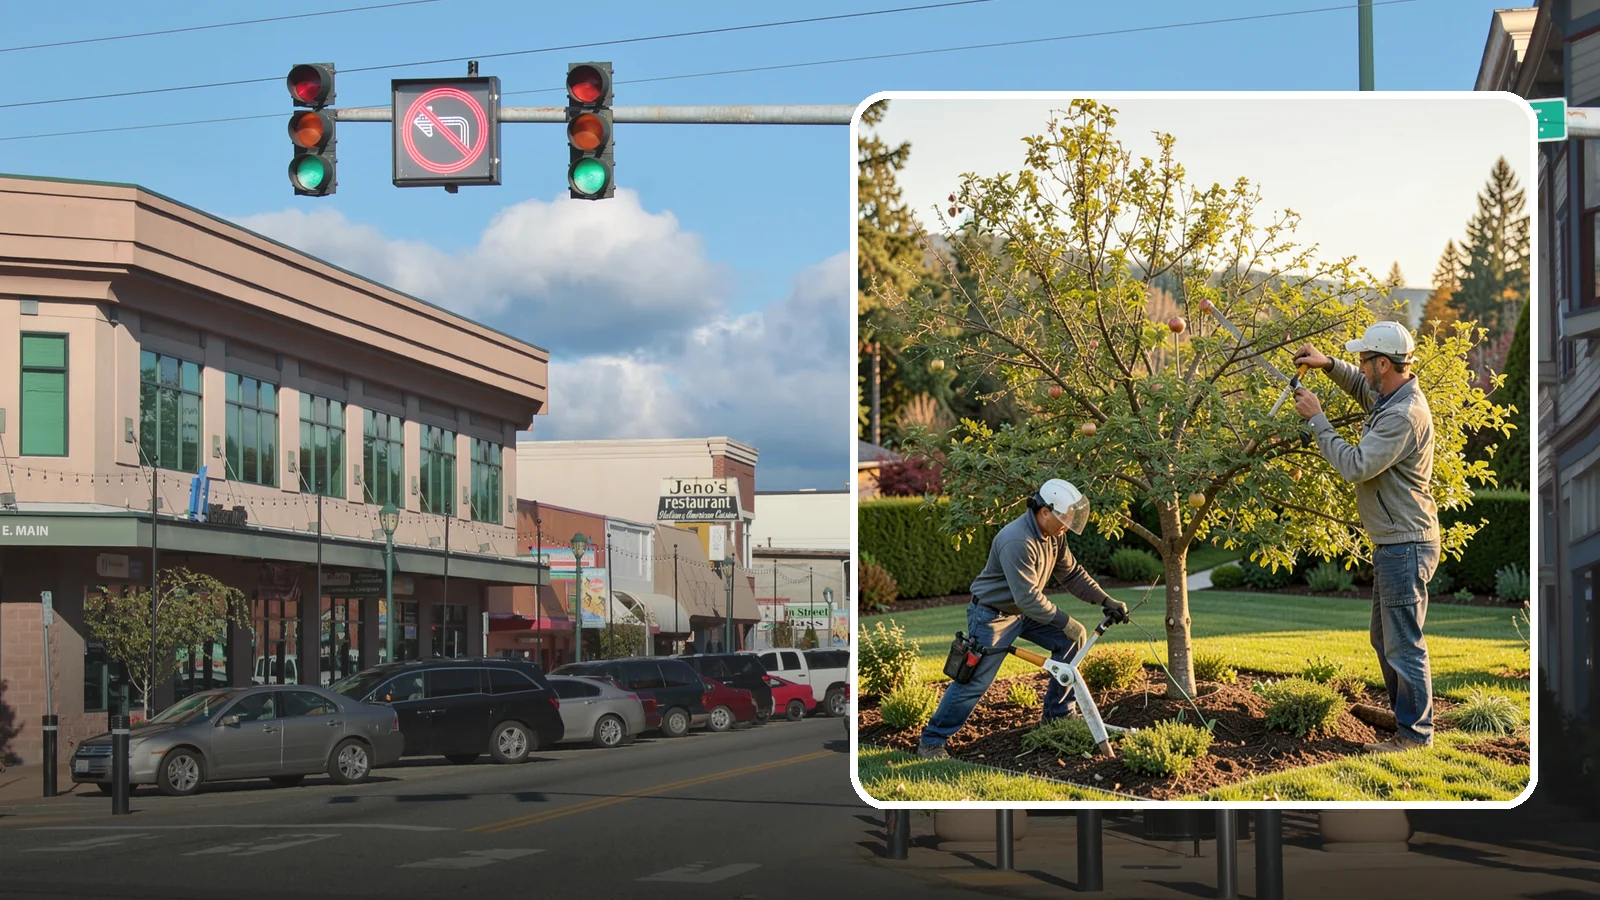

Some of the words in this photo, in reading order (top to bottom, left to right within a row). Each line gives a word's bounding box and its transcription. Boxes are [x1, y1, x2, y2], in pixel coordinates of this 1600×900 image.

[669, 480, 727, 495] Jeno's
[665, 496, 731, 509] restaurant
[658, 509, 682, 519] Italian
[686, 509, 714, 519] American
[715, 509, 738, 519] Cuisine
[2, 525, 13, 536] E.
[15, 525, 49, 536] MAIN
[785, 607, 794, 616] in
[797, 607, 828, 616] Street
[791, 618, 823, 627] lass
